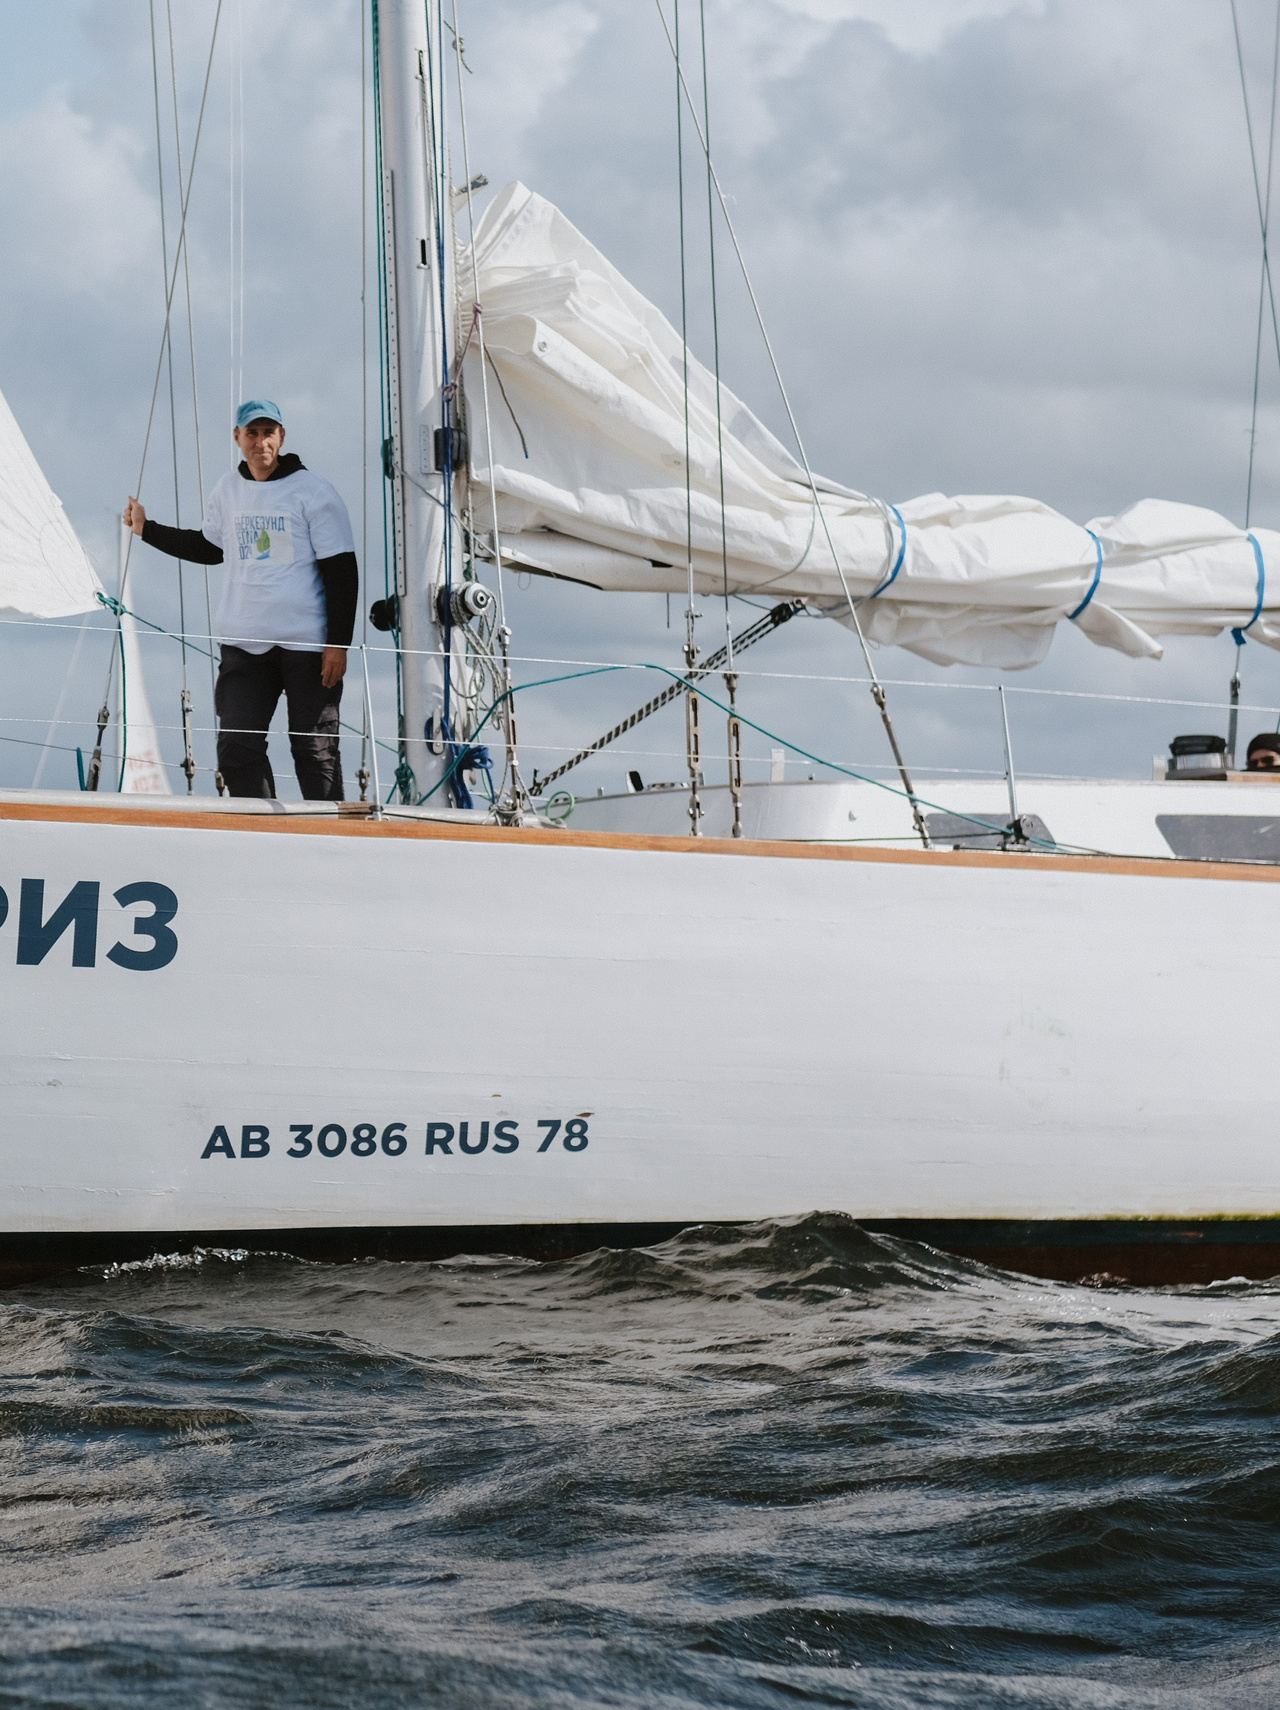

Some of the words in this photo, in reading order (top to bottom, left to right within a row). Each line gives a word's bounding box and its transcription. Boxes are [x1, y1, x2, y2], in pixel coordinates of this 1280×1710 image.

[200, 1124, 271, 1159] AB
[286, 1122, 408, 1159] 3086
[425, 1120, 520, 1155] RUS
[536, 1118, 589, 1153] 78
